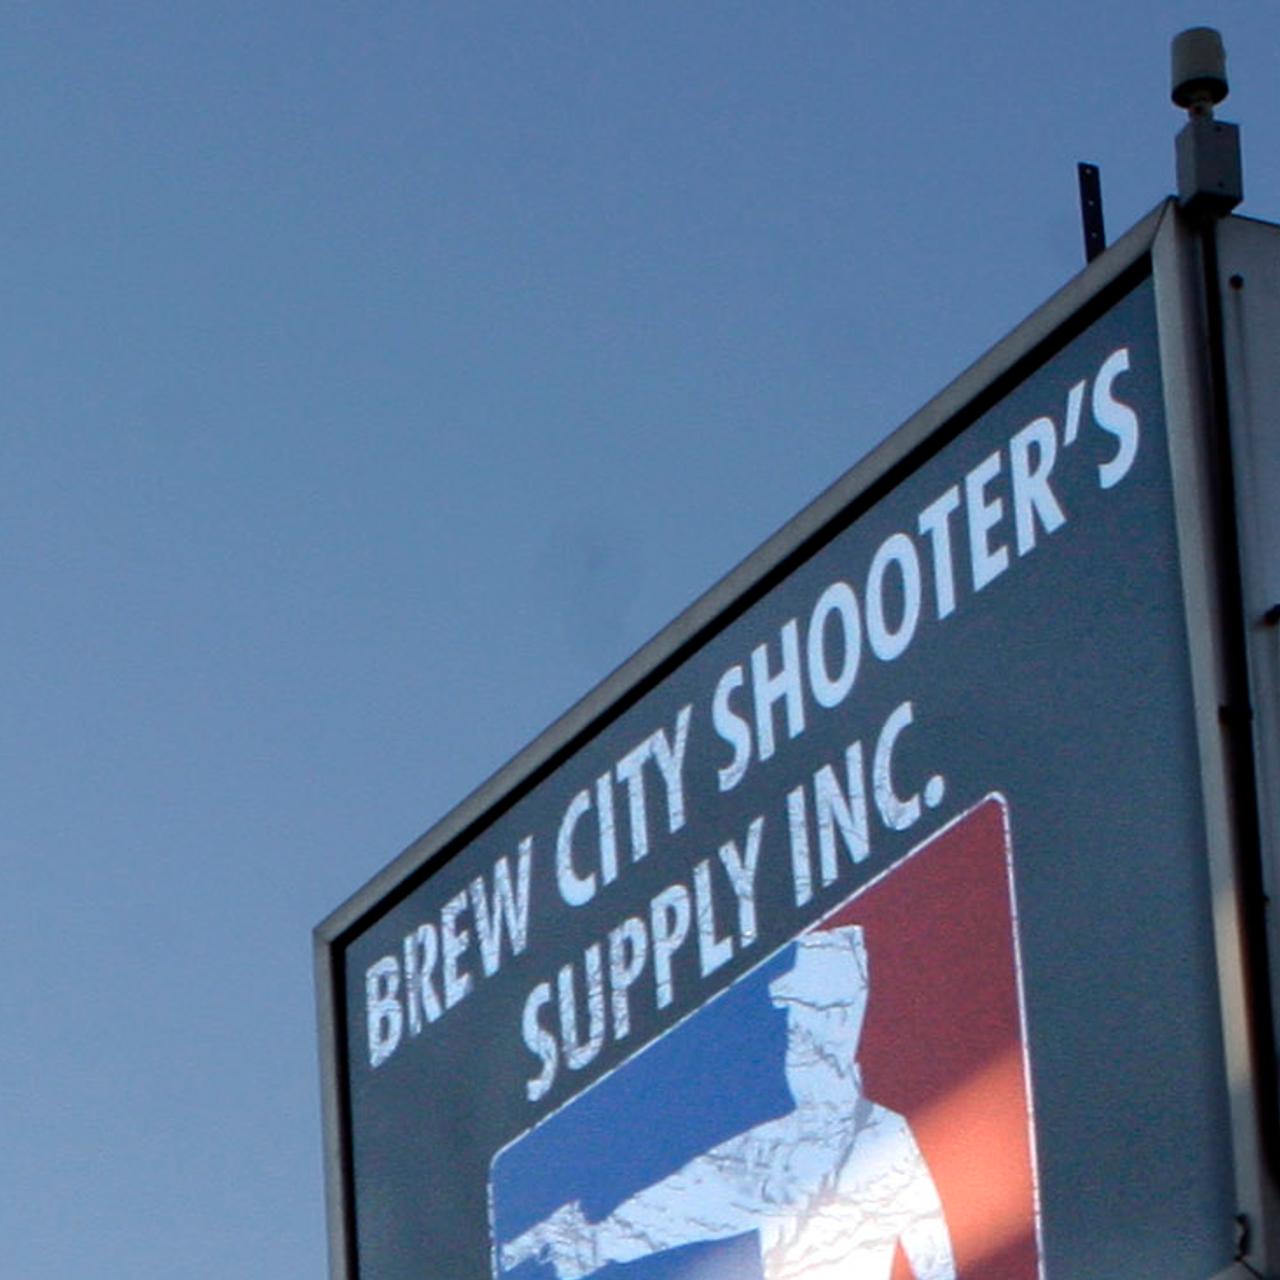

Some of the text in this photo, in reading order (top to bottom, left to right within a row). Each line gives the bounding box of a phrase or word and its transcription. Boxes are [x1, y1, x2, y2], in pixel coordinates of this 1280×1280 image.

[365, 348, 1139, 1068] BREW CITY SHOOTER'S
[522, 701, 945, 1102] SUPPLY INC.
